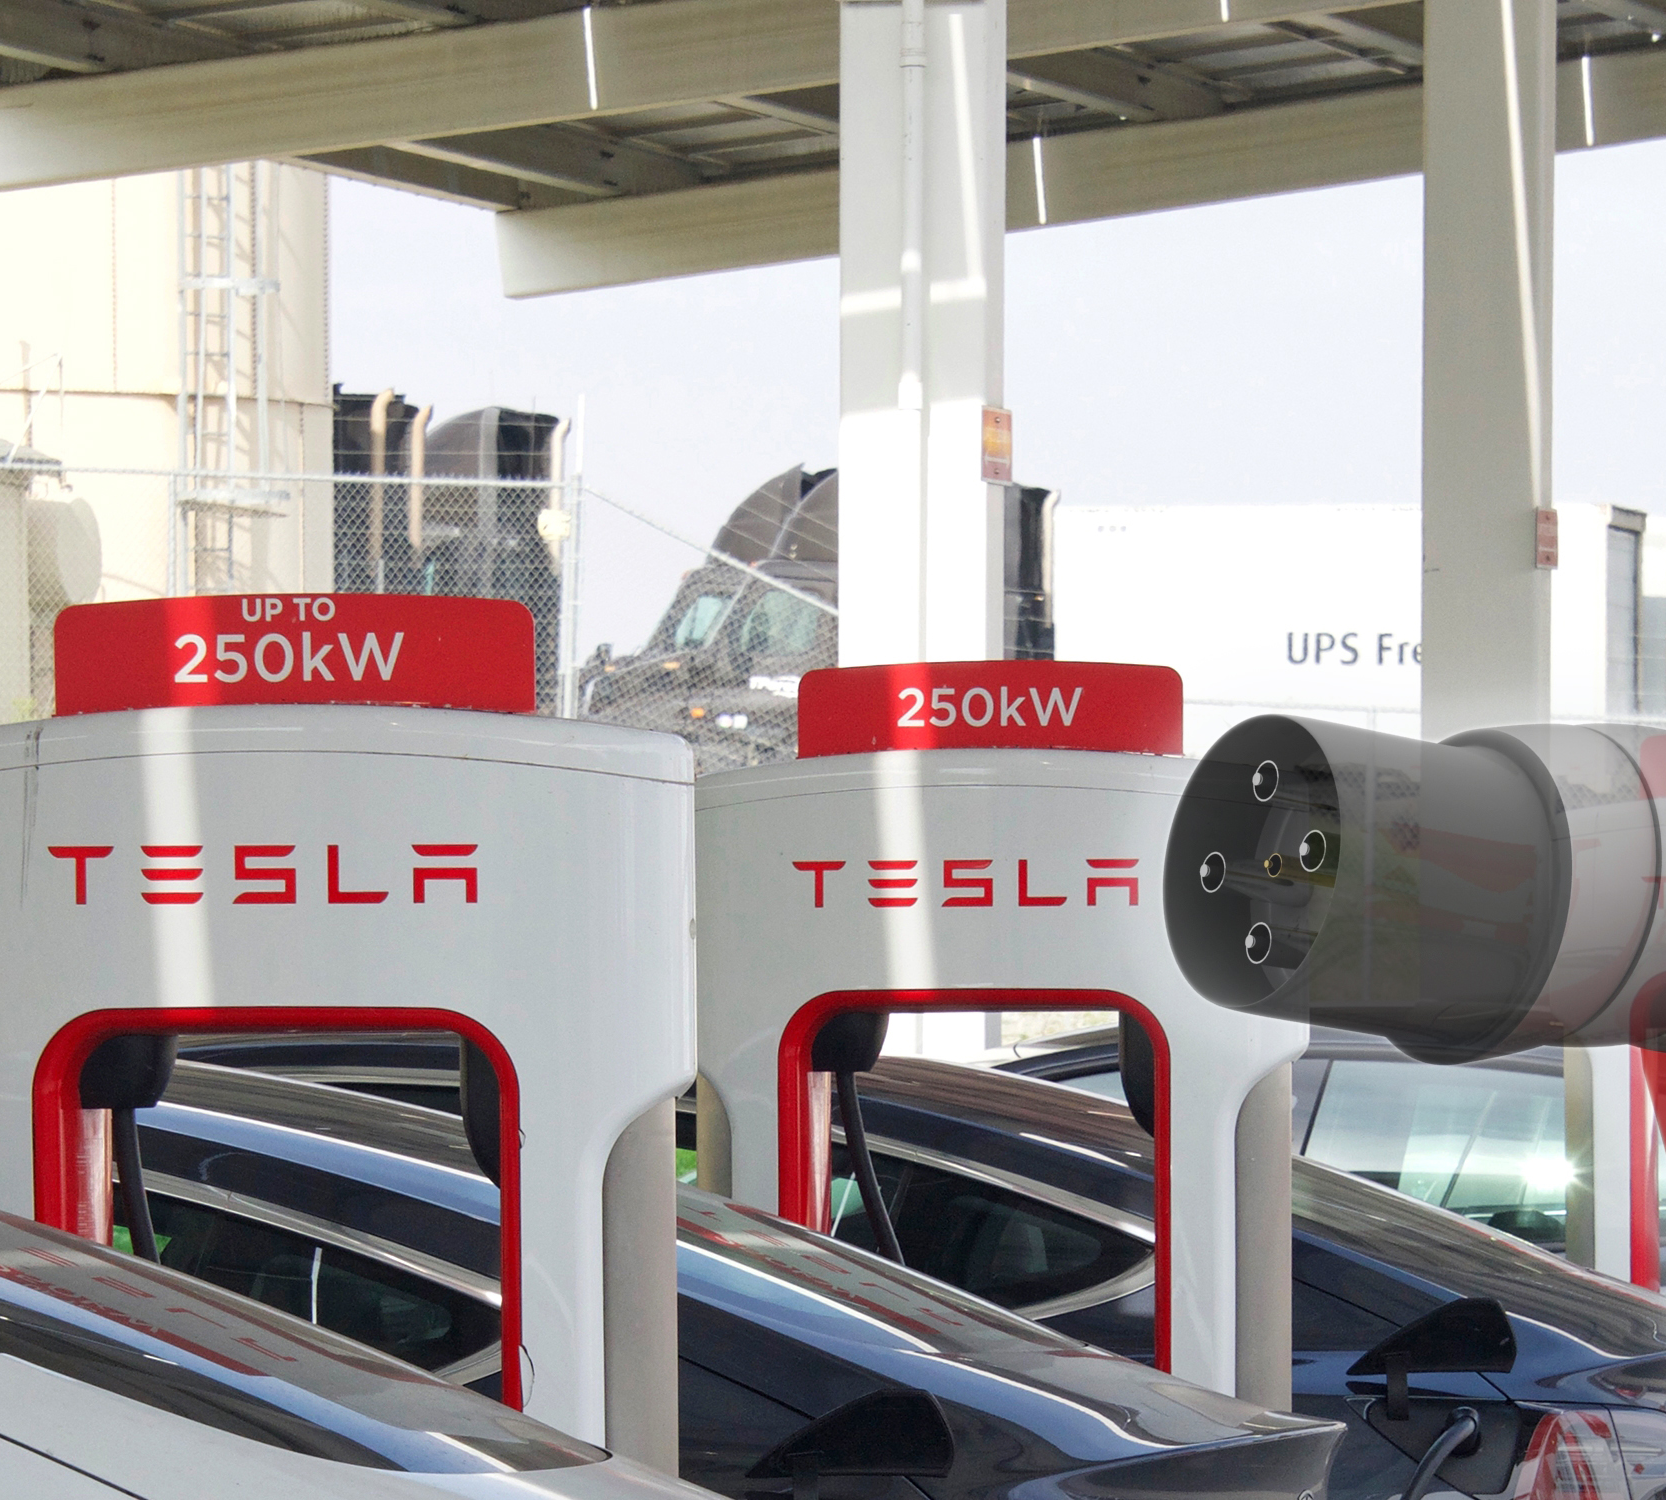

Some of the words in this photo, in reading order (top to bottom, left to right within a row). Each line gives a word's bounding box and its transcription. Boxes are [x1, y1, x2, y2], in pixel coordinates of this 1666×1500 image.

[241, 597, 283, 623] UP
[292, 597, 336, 622] TO
[174, 631, 405, 684] 250kW
[1287, 632, 1359, 665] UPS
[896, 686, 1083, 728] 250kW
[48, 843, 478, 905] TESLA
[793, 859, 1138, 909] TESLA
